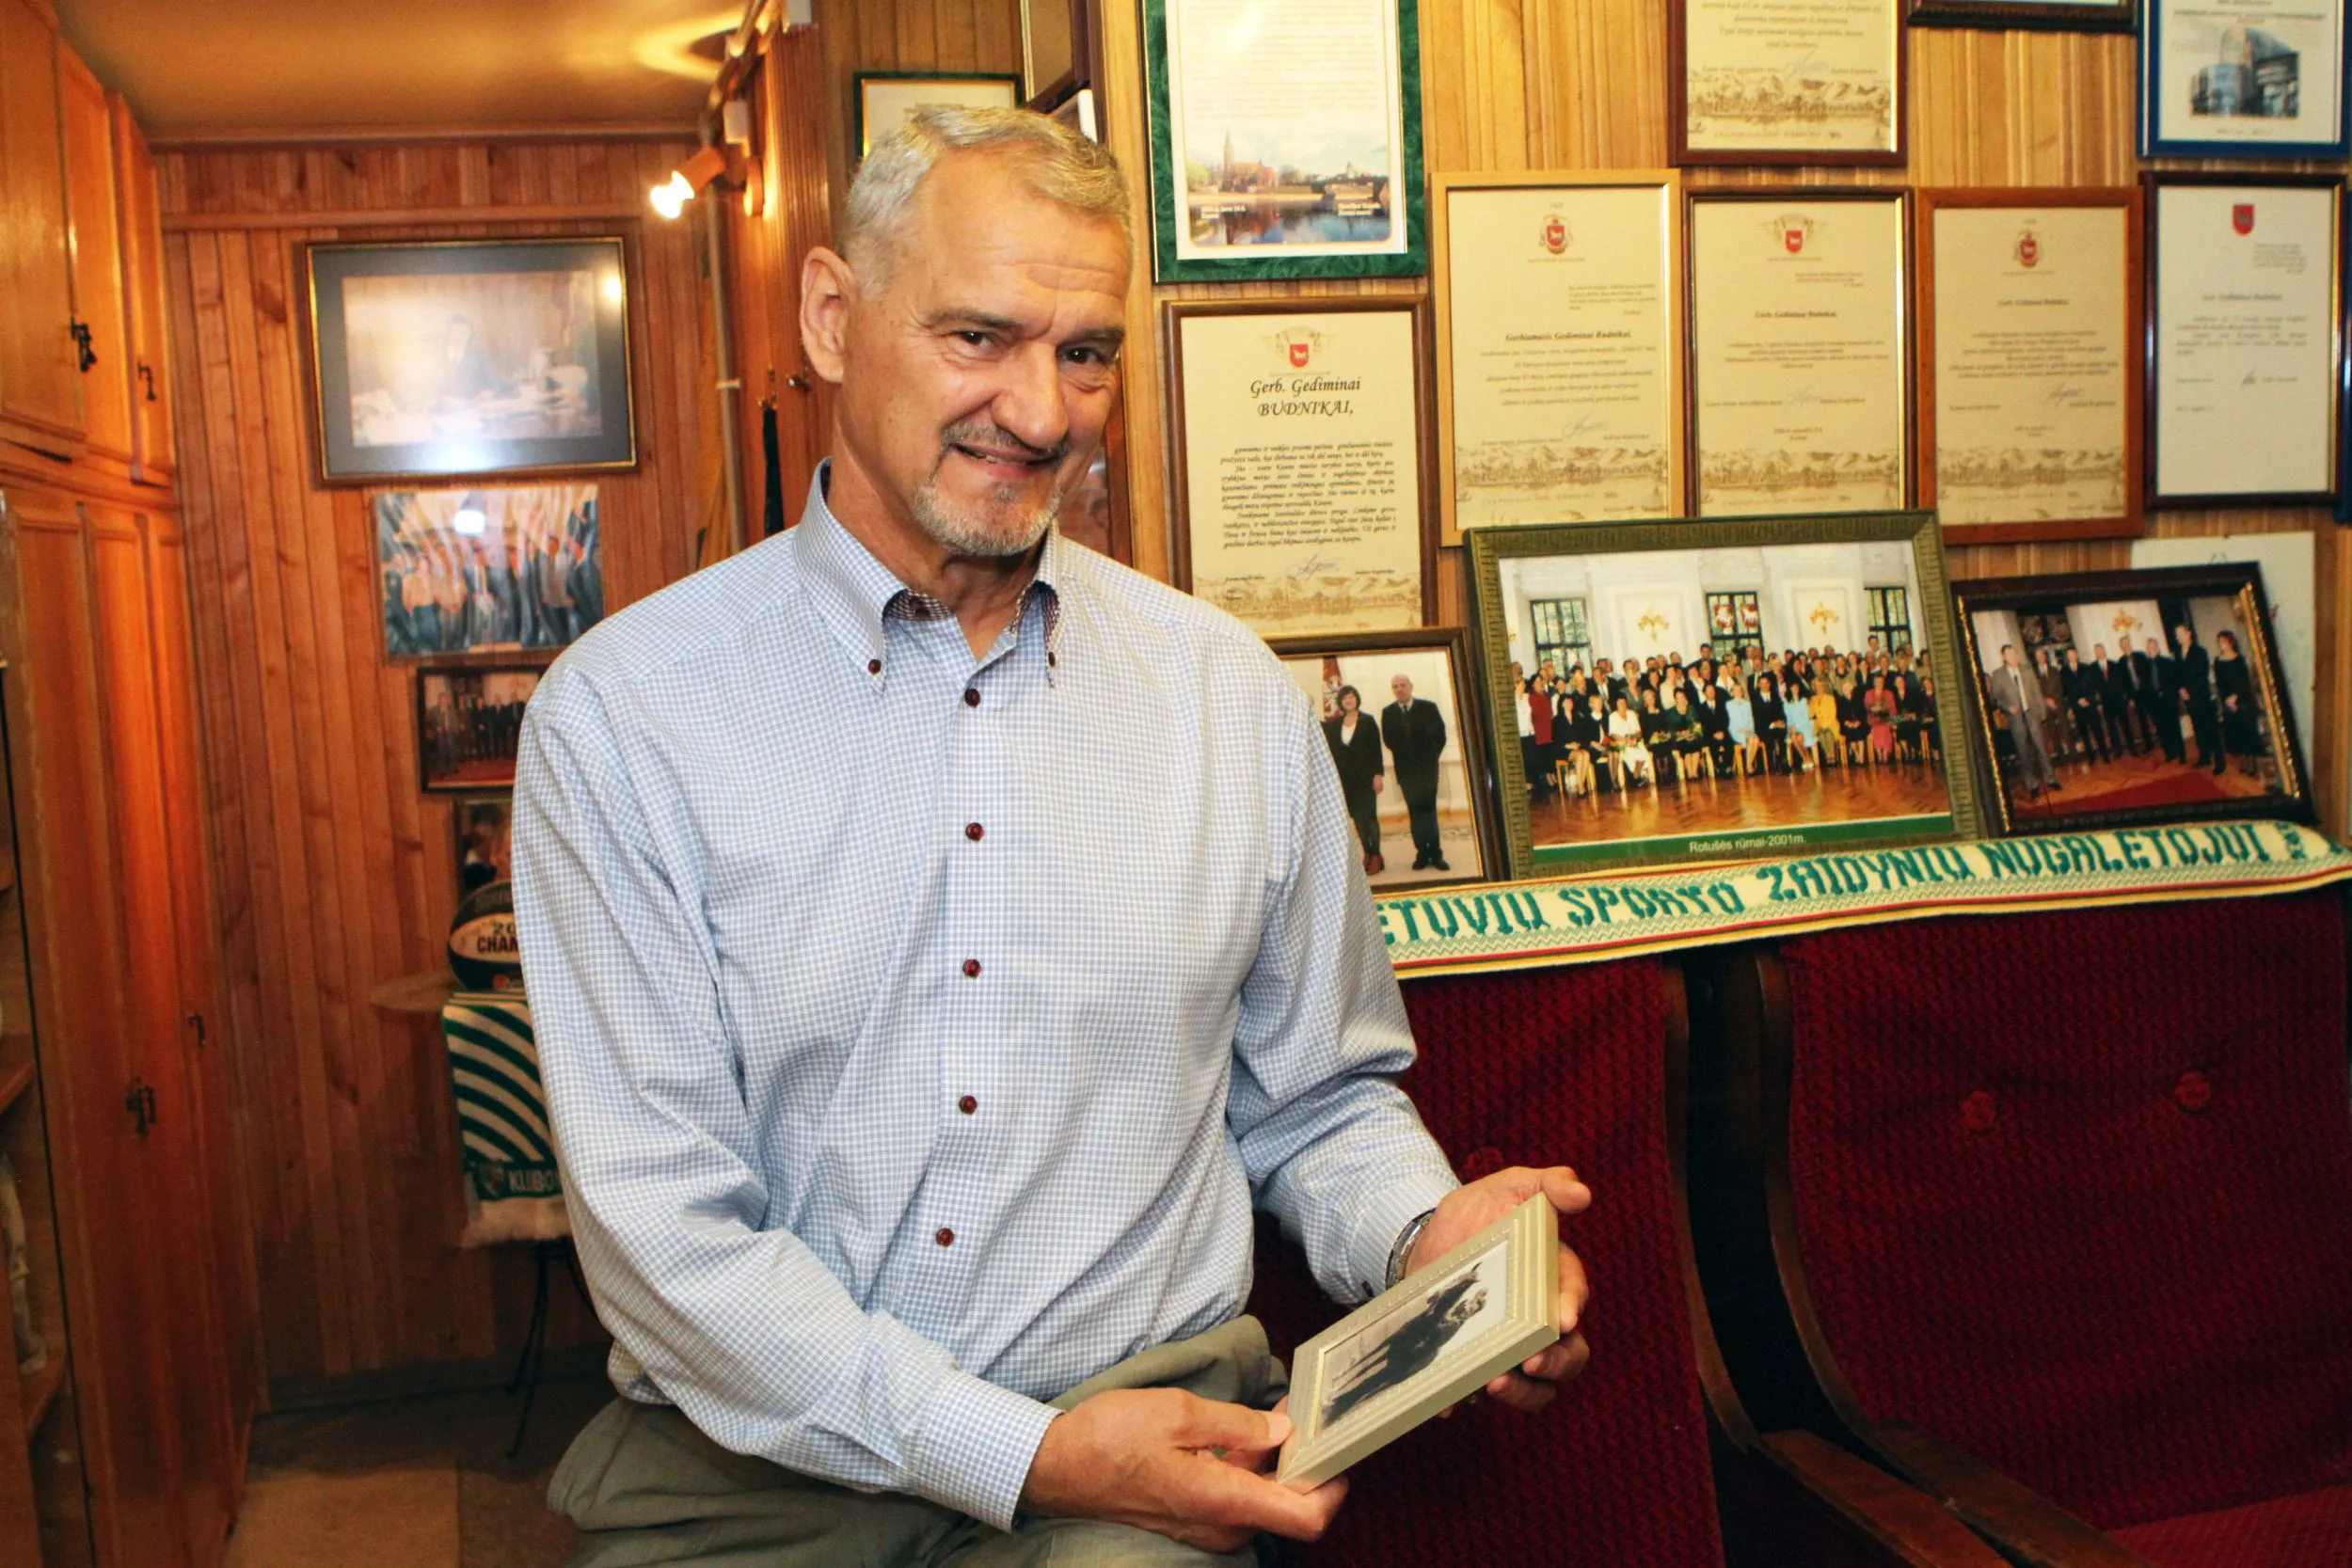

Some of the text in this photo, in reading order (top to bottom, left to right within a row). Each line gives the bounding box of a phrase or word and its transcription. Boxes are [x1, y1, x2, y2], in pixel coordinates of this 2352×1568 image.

[1250, 376, 1361, 399] Gerb. Gediminai
[1258, 400, 1354, 417] BUDNIKAI,
[1558, 881, 1745, 926] SPORTO
